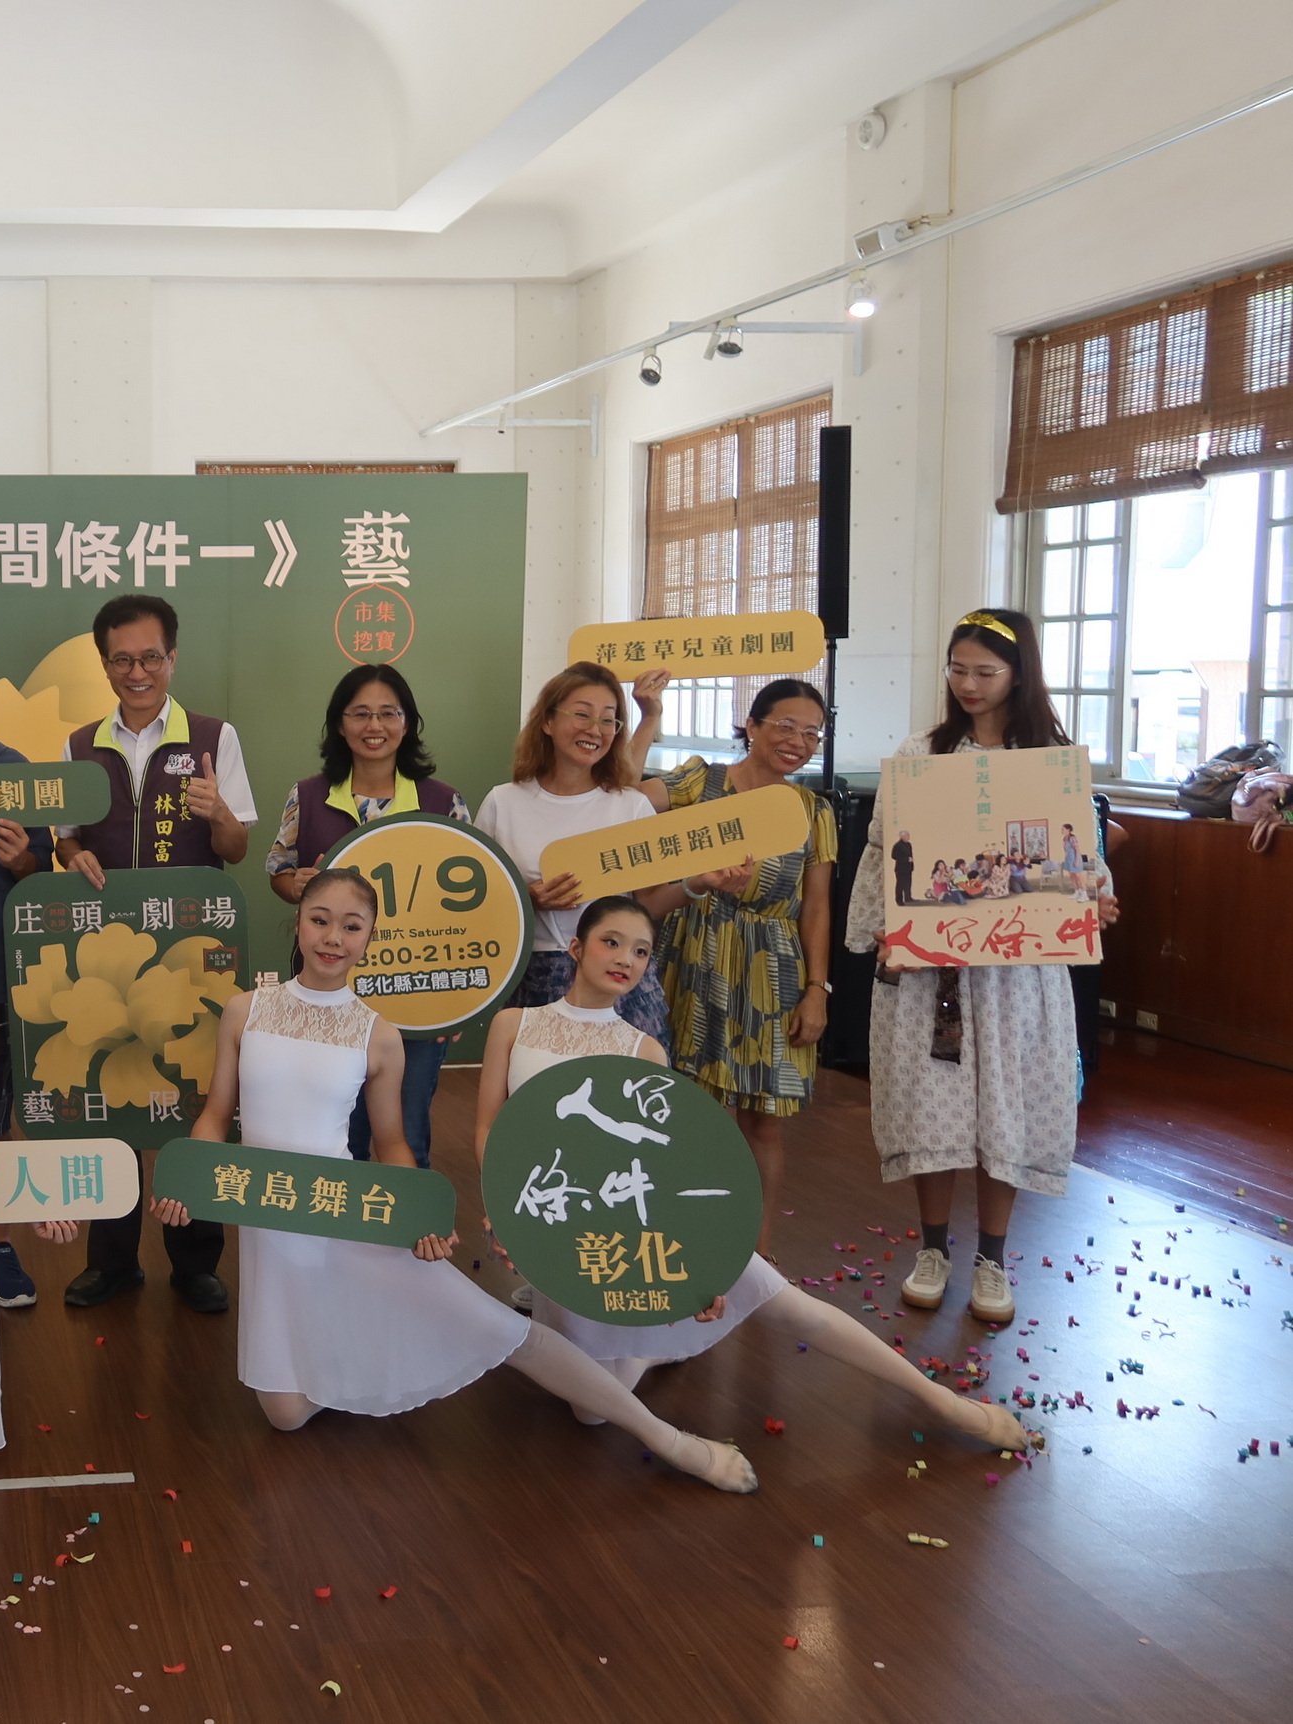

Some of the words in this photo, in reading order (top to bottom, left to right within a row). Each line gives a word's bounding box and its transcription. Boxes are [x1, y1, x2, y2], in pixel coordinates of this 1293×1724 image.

[341, 510, 410, 588] 藝
[354, 601, 396, 622] 市集
[353, 631, 396, 652] 挖寶
[154, 793, 176, 863] 林田富
[597, 816, 744, 875] 員圓舞蹈團
[347, 856, 488, 918] 1/9
[409, 926, 467, 939] Saturday
[356, 968, 489, 996] 彰化縣立體育場
[213, 1164, 397, 1225] 寶島舞台
[575, 1231, 689, 1285] 彰化
[603, 1290, 672, 1312] 限定版
